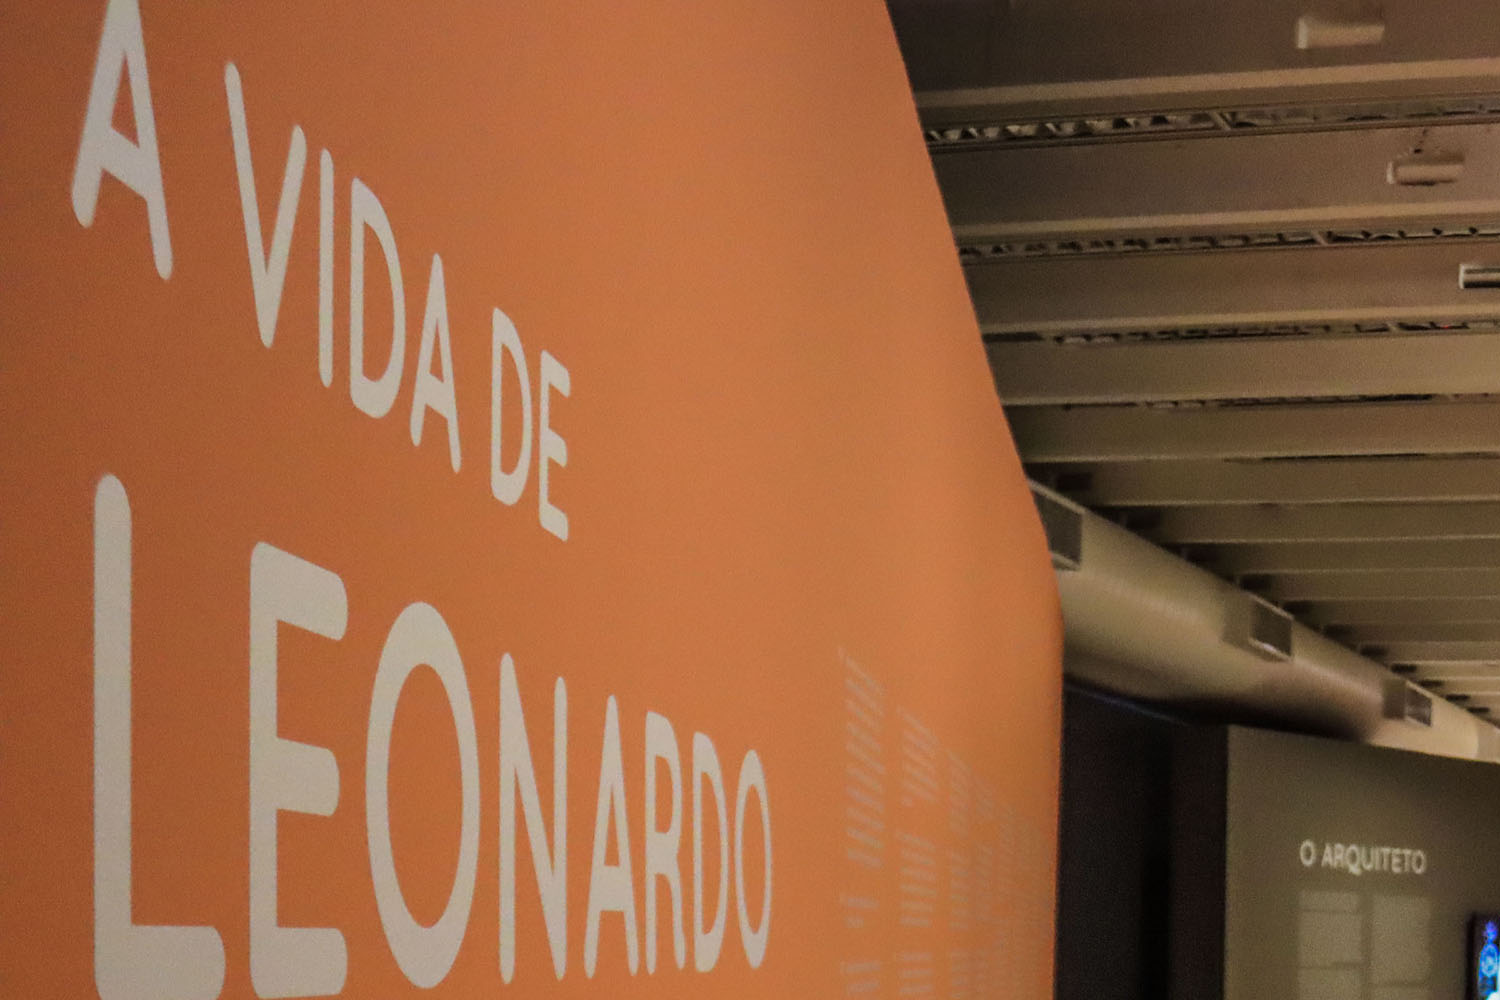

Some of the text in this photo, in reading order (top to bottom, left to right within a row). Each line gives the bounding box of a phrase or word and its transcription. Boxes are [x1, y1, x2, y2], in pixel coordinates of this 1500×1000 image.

[72, 0, 571, 542] A VIDA DE
[1300, 839, 1426, 876] O ARQUITETO
